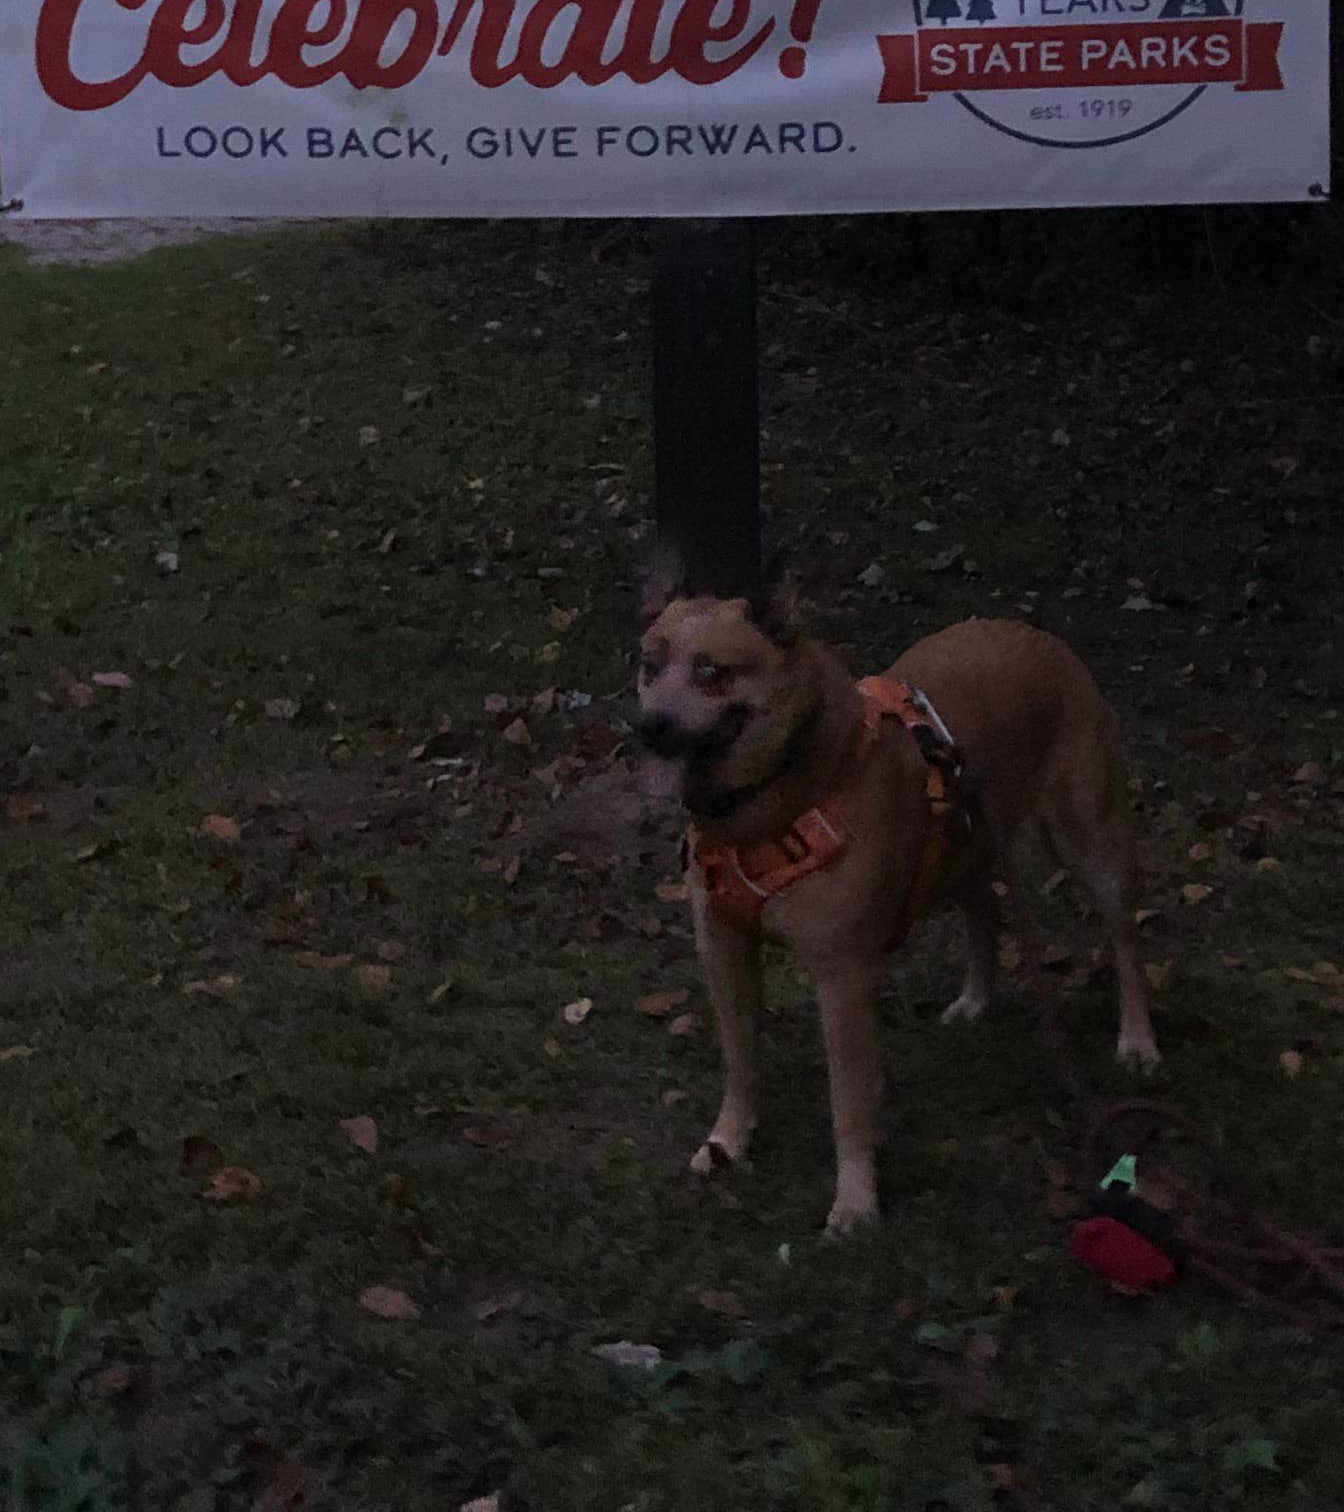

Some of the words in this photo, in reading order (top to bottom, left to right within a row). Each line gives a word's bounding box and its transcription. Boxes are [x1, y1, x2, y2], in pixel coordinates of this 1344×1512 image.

[929, 39, 1065, 76] STATE
[1080, 34, 1232, 71] PARKS
[1029, 101, 1070, 120] est.
[1079, 98, 1134, 120] 1919
[156, 125, 288, 160] LOOK
[303, 126, 452, 167] BACK,
[463, 126, 576, 159] GIVE
[591, 121, 860, 158] FORWARD.
